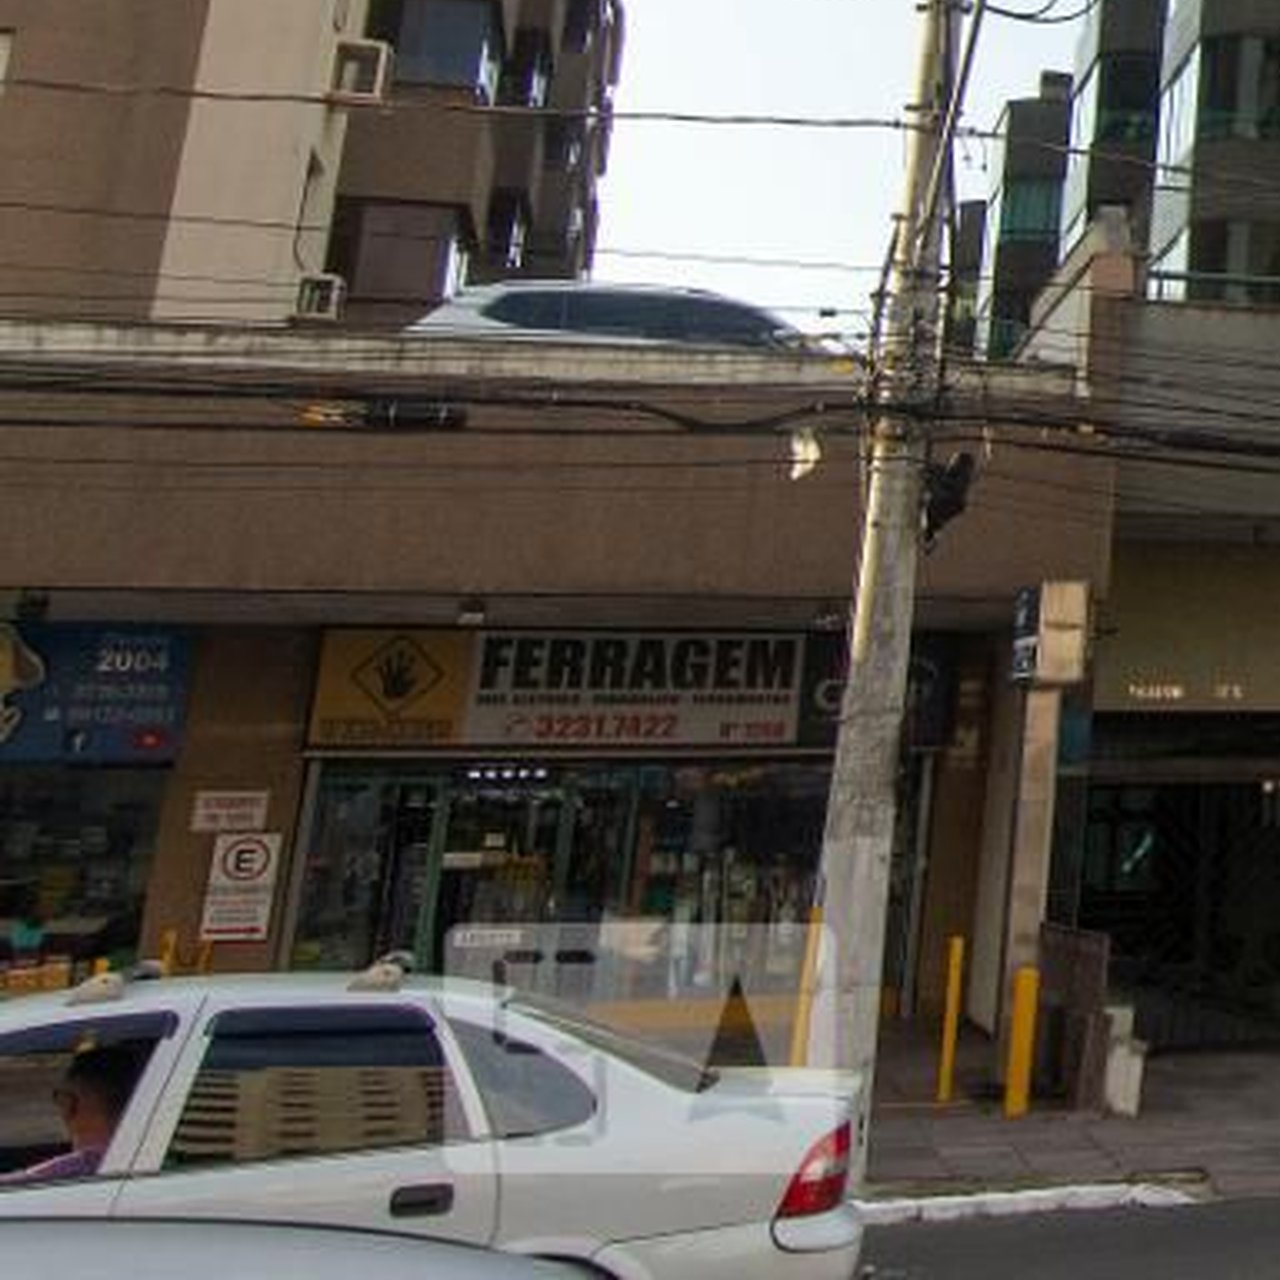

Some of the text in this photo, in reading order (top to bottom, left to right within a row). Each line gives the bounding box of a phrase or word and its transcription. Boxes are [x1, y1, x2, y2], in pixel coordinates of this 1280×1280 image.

[96, 648, 170, 672] 2004
[479, 637, 797, 691] FERRAGEM
[234, 849, 257, 874] E
